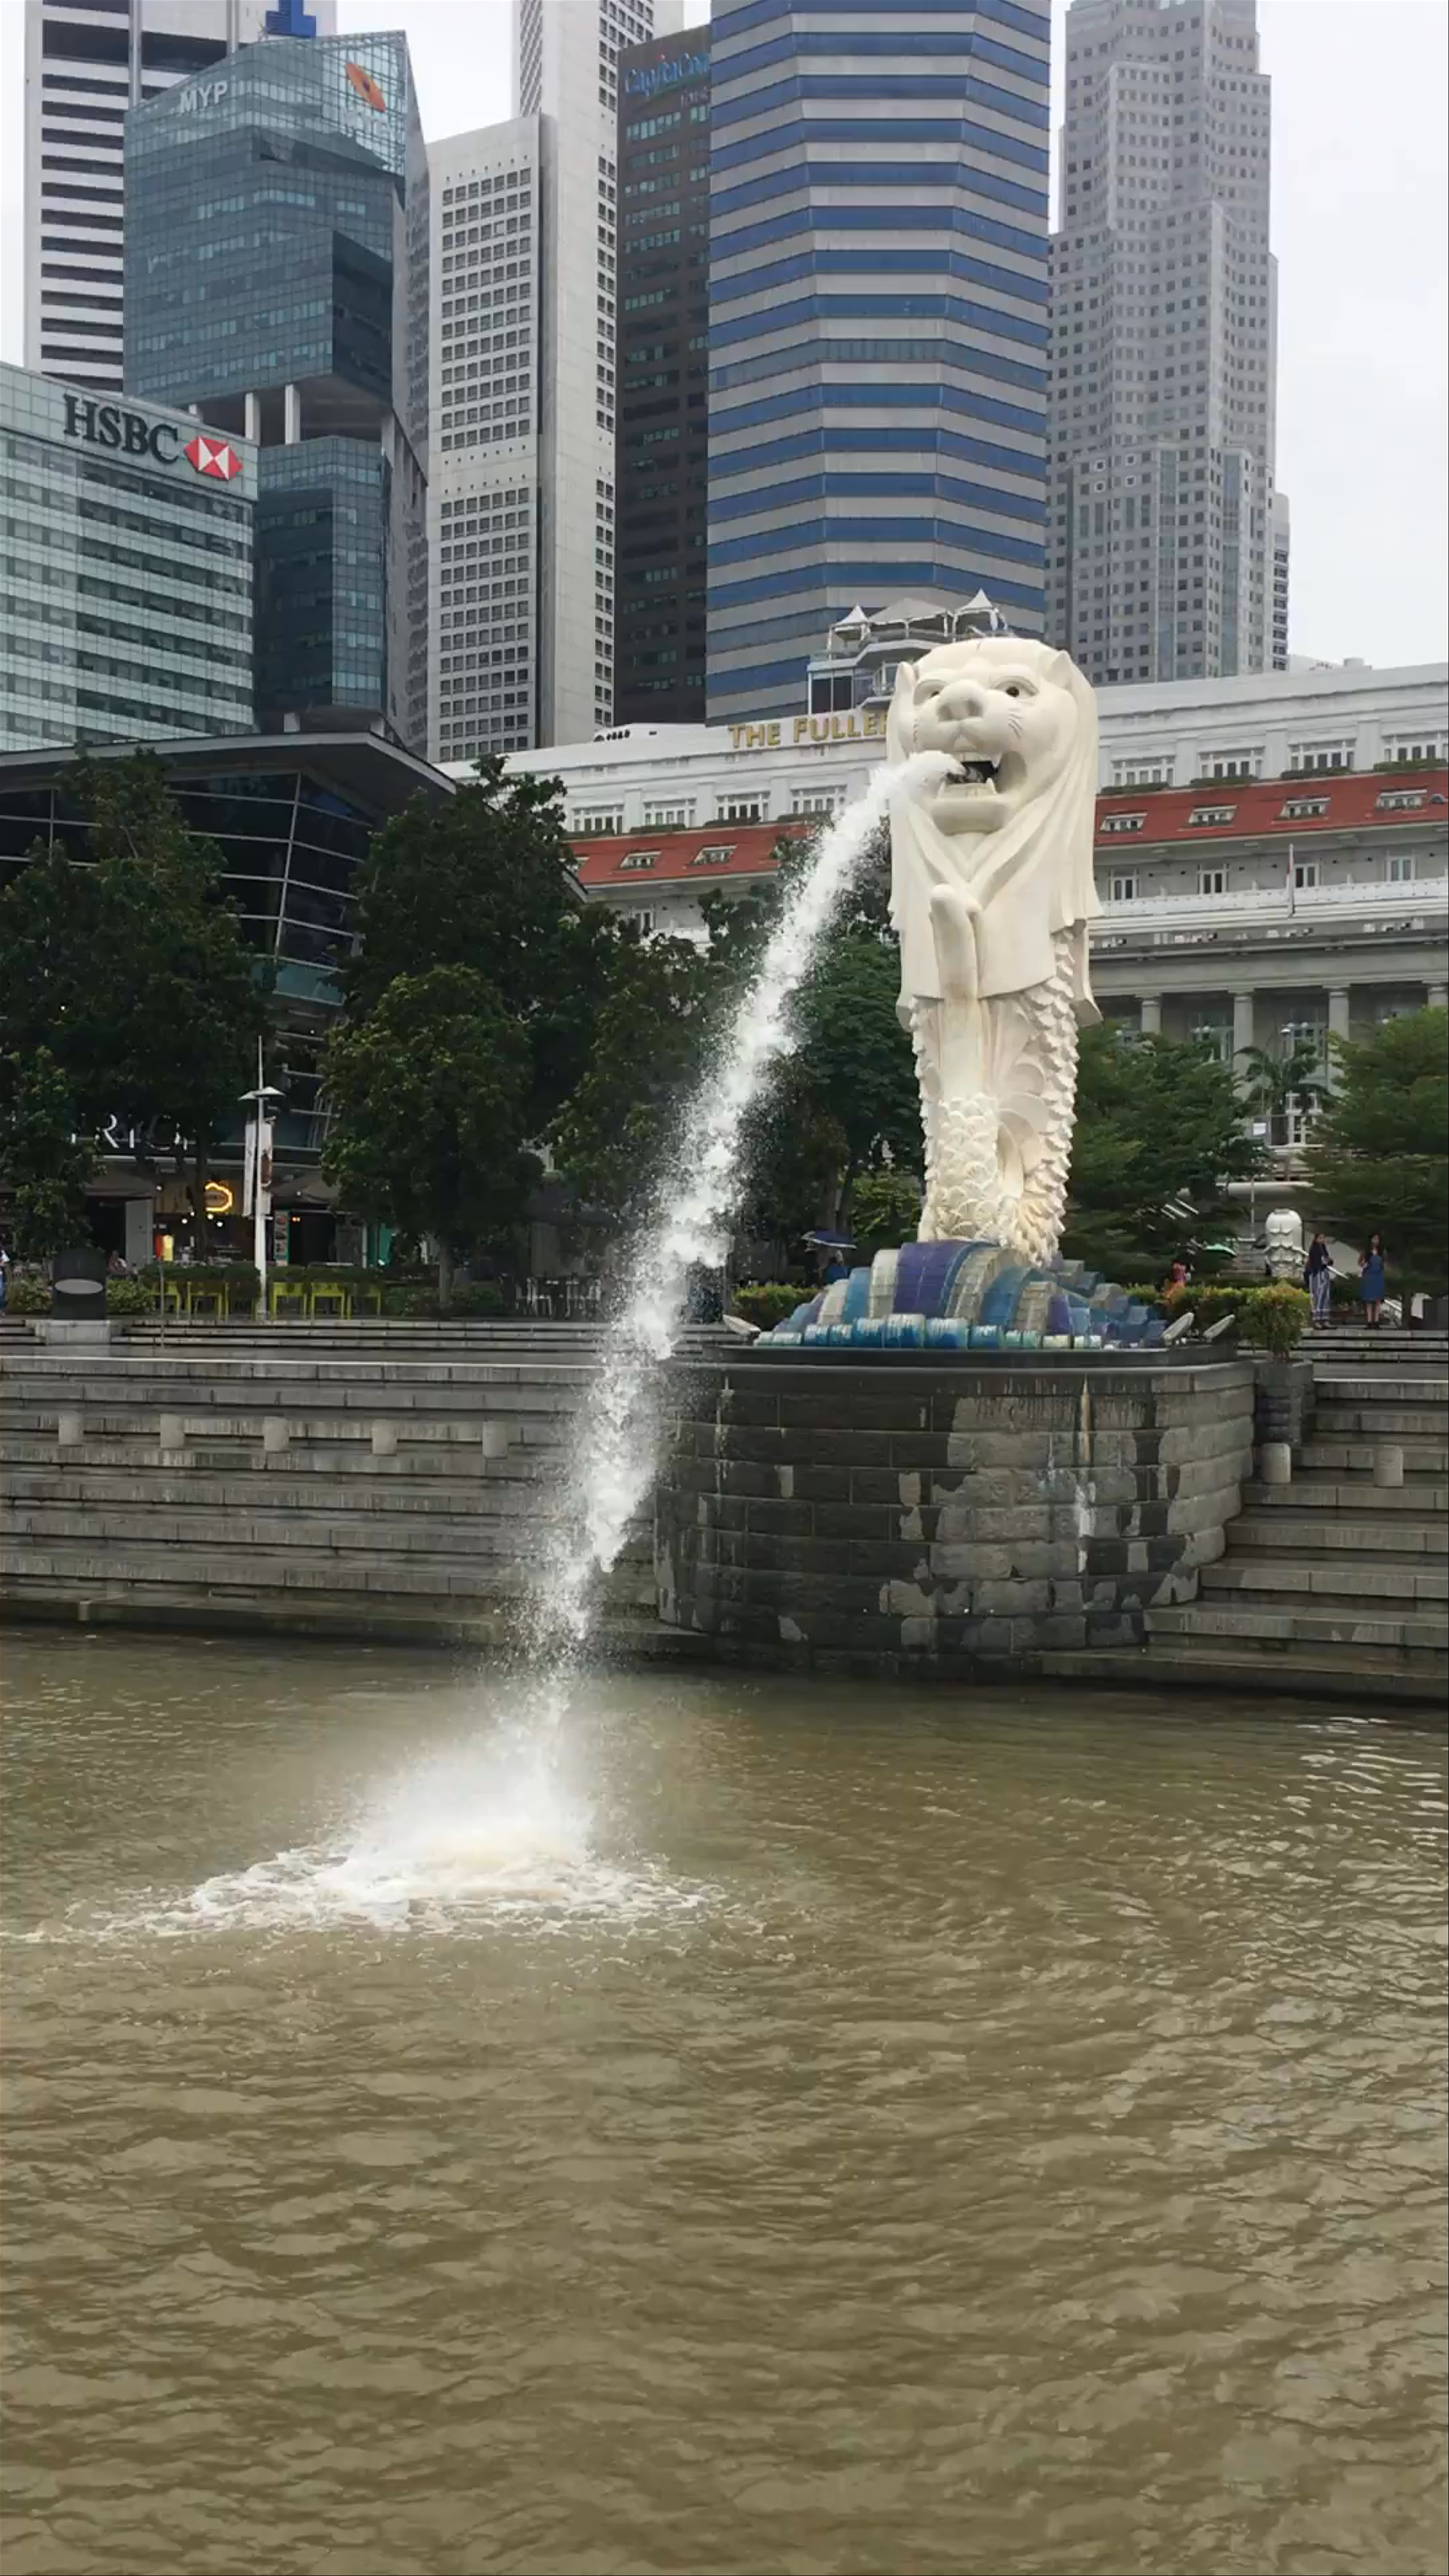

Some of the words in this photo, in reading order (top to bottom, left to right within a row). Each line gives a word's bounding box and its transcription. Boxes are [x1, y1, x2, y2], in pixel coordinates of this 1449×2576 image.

[179, 80, 228, 113] MYP
[63, 394, 179, 464] HSBC
[728, 723, 781, 749] THE
